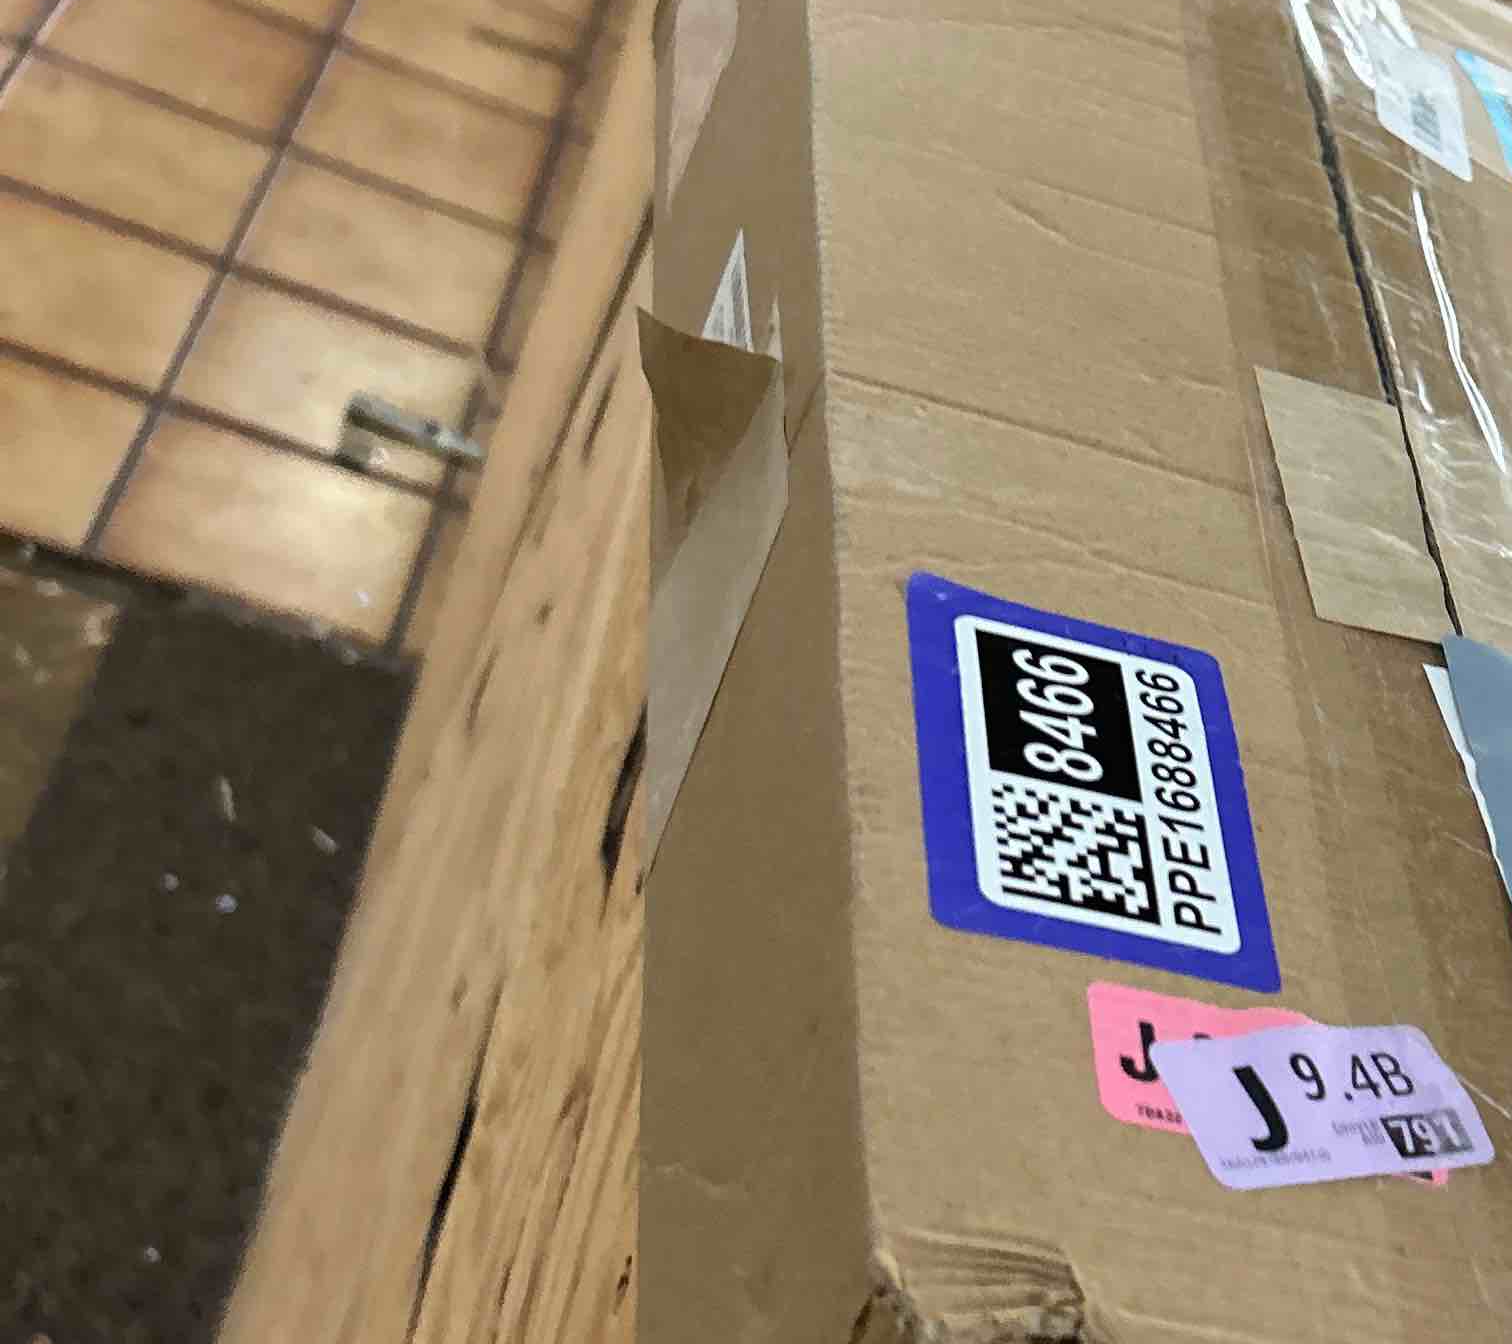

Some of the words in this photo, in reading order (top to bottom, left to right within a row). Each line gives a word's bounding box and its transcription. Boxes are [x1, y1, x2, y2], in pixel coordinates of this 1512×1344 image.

[1013, 648, 1101, 783] 8466
[1134, 668, 1222, 936] PPE1688466
[1233, 1065, 1289, 1152] J
[1388, 1116, 1466, 1158] 791
